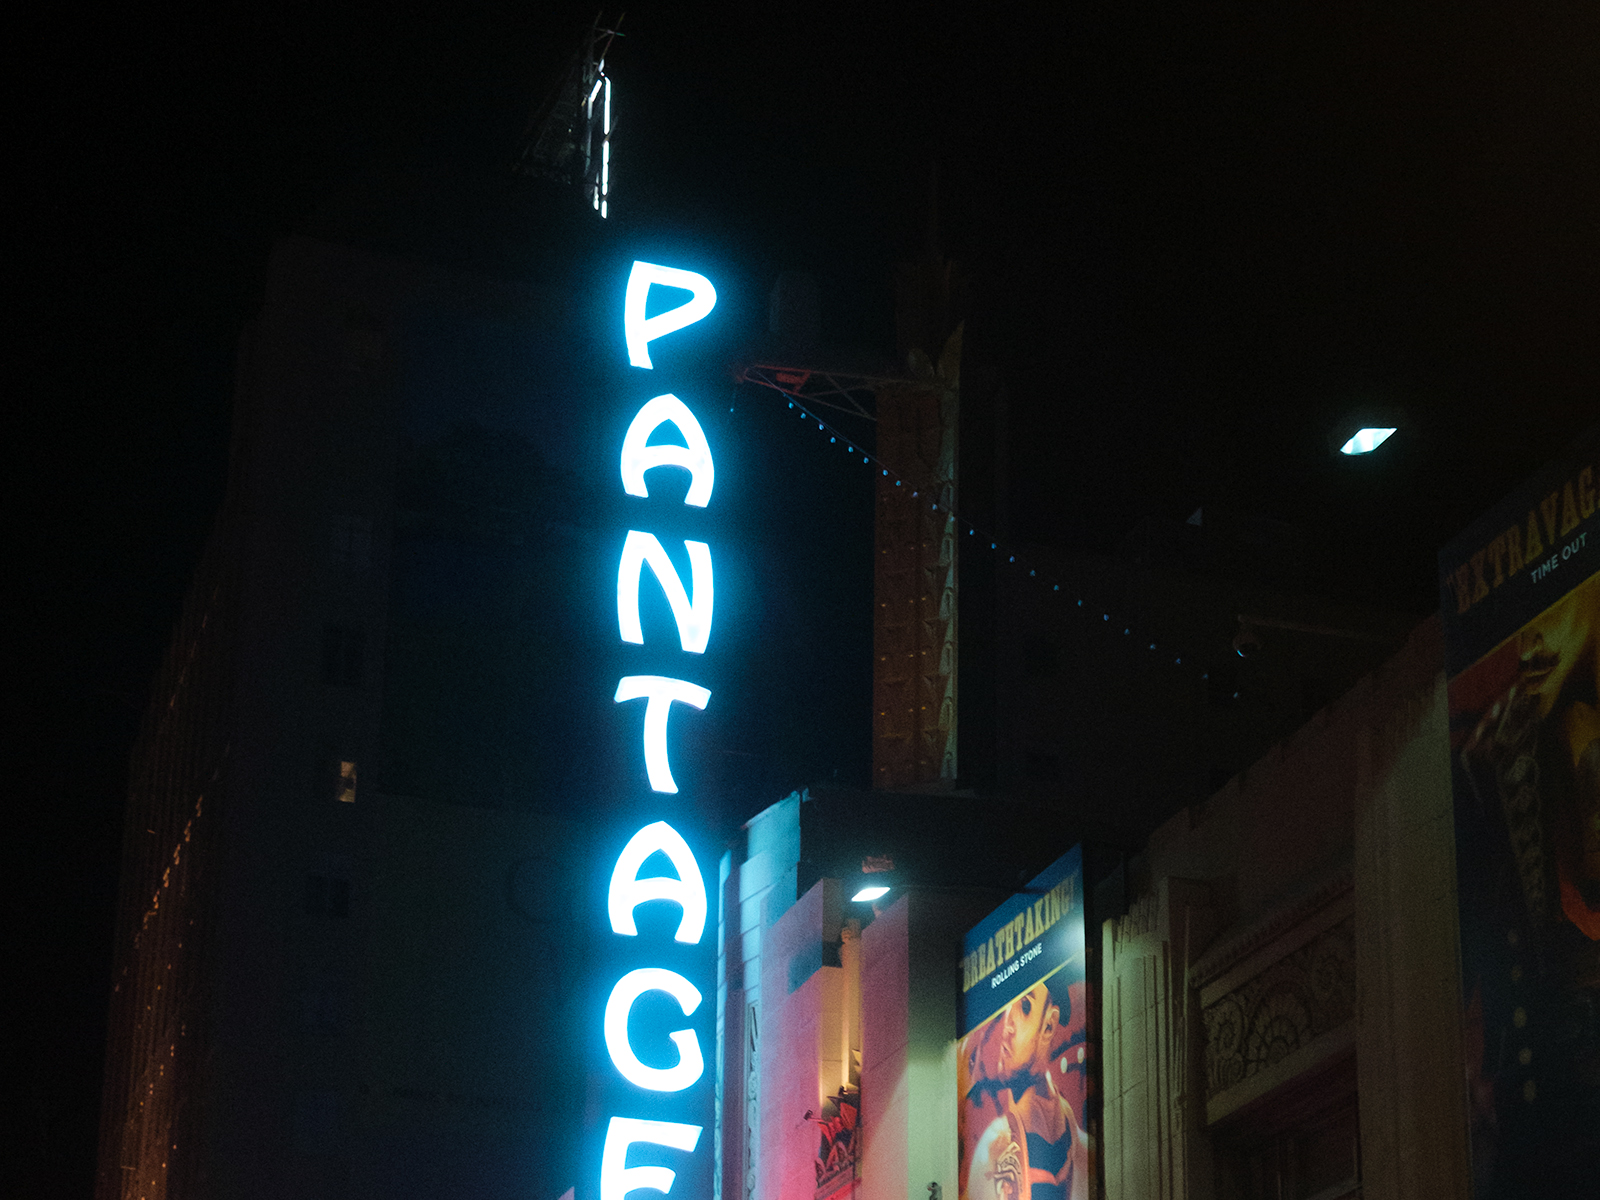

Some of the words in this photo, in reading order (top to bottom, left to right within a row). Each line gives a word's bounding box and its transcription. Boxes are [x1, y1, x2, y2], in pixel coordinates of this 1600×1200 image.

[1530, 553, 1558, 583] TIME
[1562, 531, 1588, 561] OUT
[991, 959, 1021, 989] ROLLING
[1020, 942, 1043, 967] STONE
